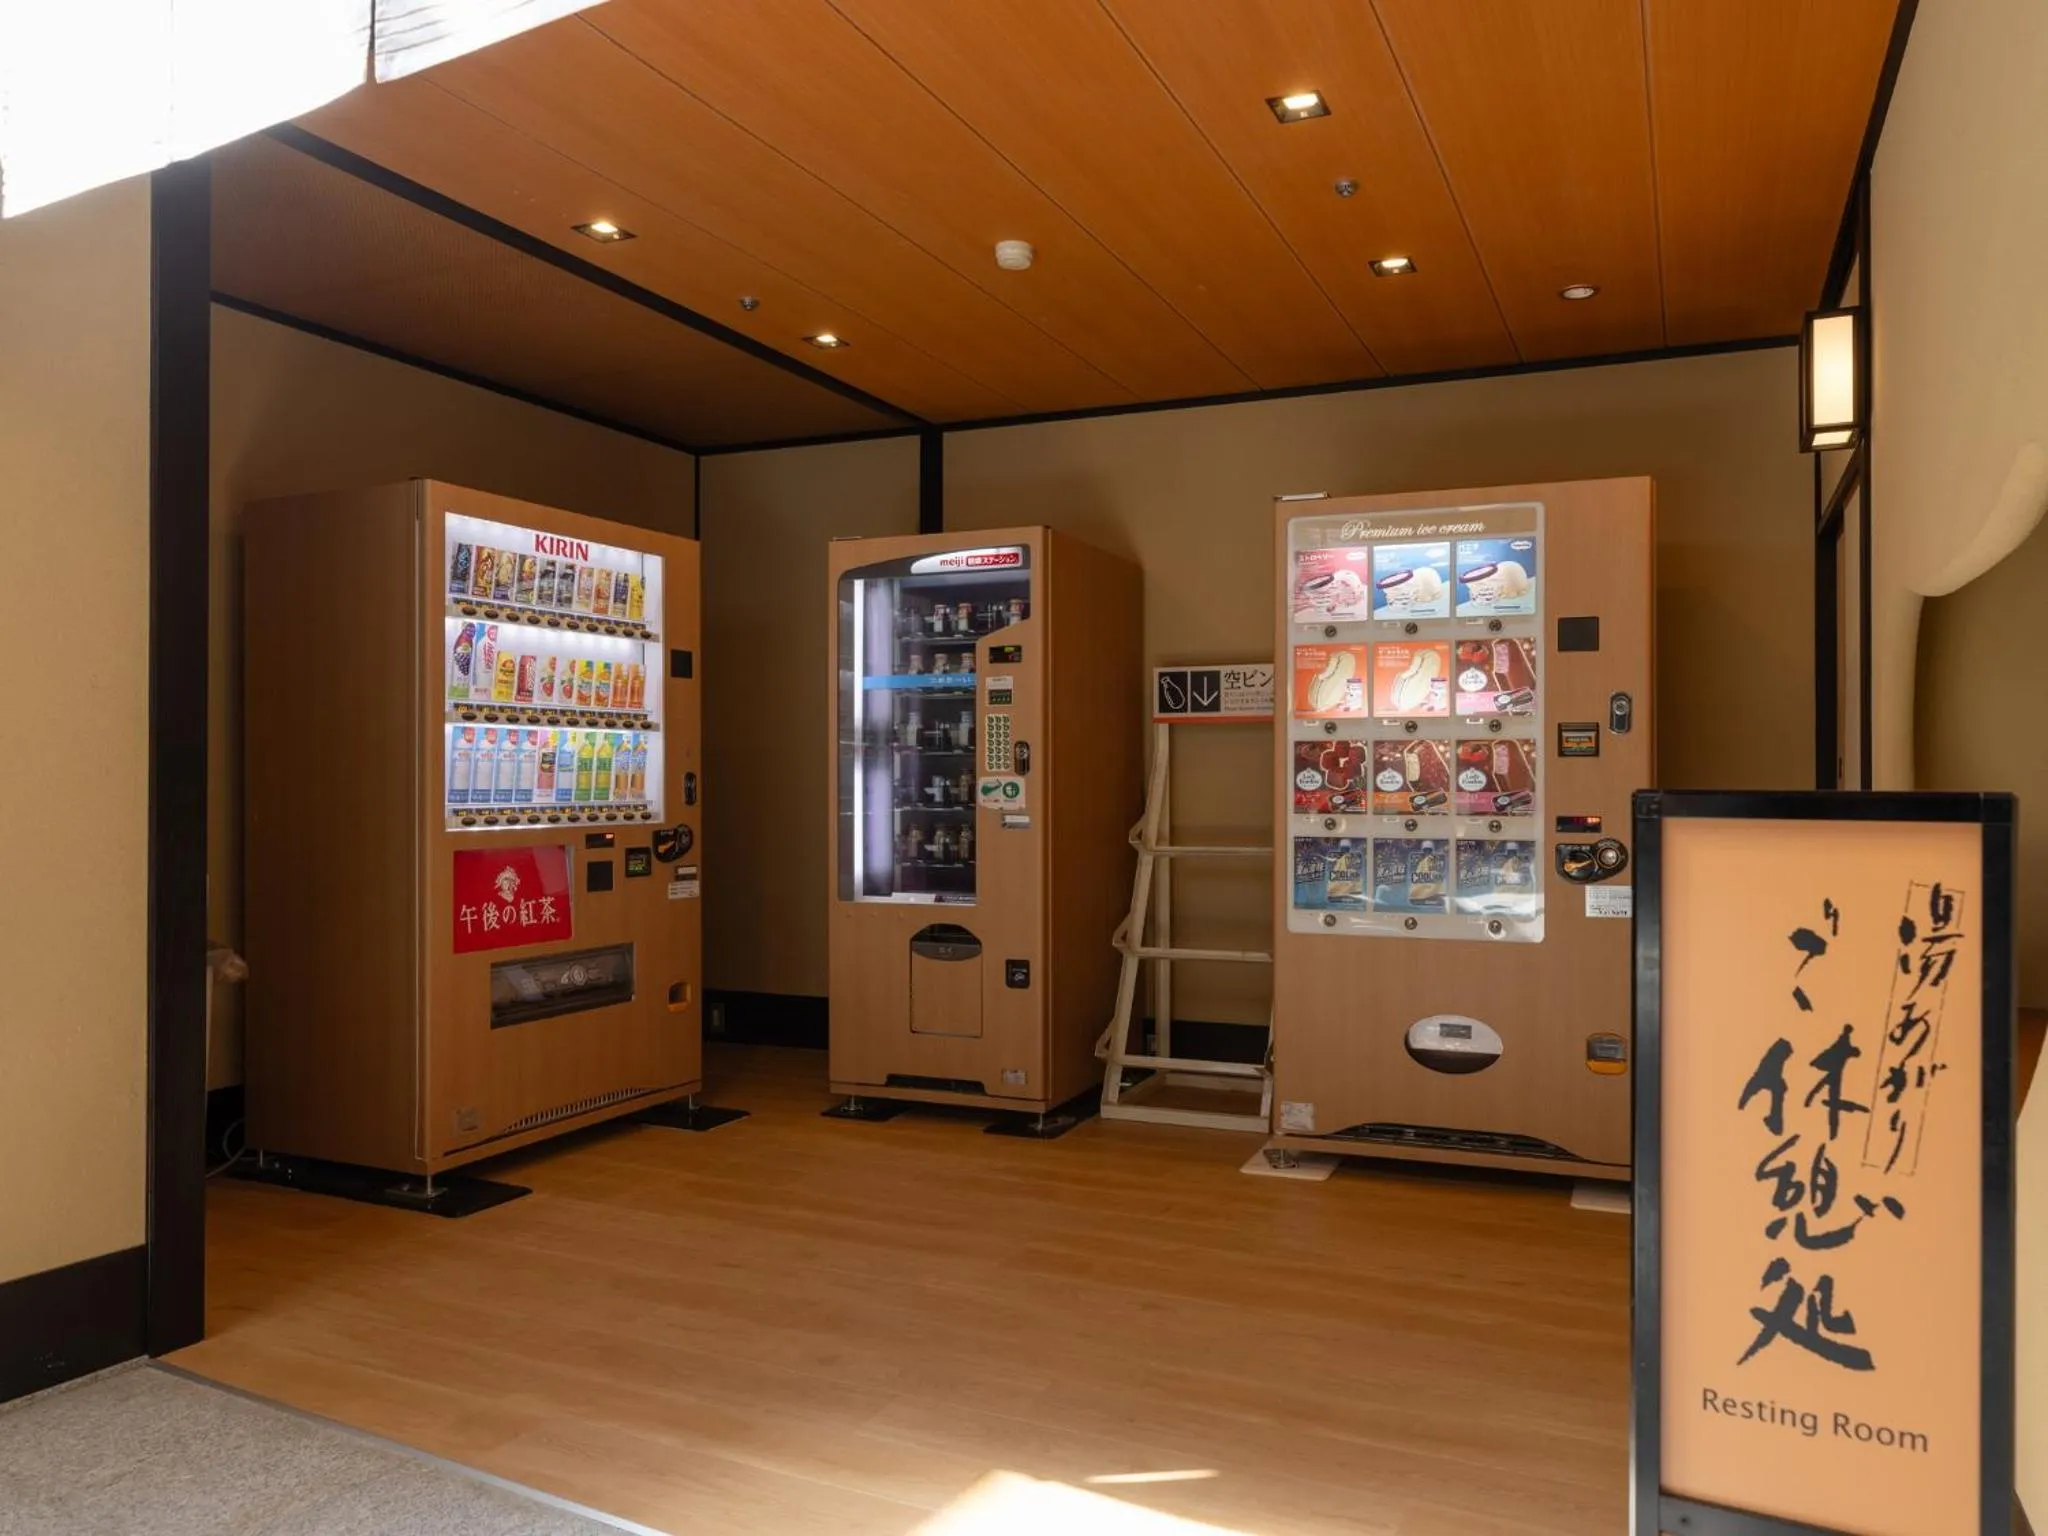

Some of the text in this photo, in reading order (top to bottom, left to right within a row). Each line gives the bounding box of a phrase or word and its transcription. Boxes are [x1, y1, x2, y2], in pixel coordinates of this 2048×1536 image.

[1341, 519, 1485, 539] Premium ice cream
[535, 534, 588, 561] KIRIN
[940, 557, 964, 567] meiji
[460, 896, 556, 934] 午後の紅茶
[1737, 898, 1905, 1371] ご休憩処
[1702, 1388, 1929, 1452] Resting Room
